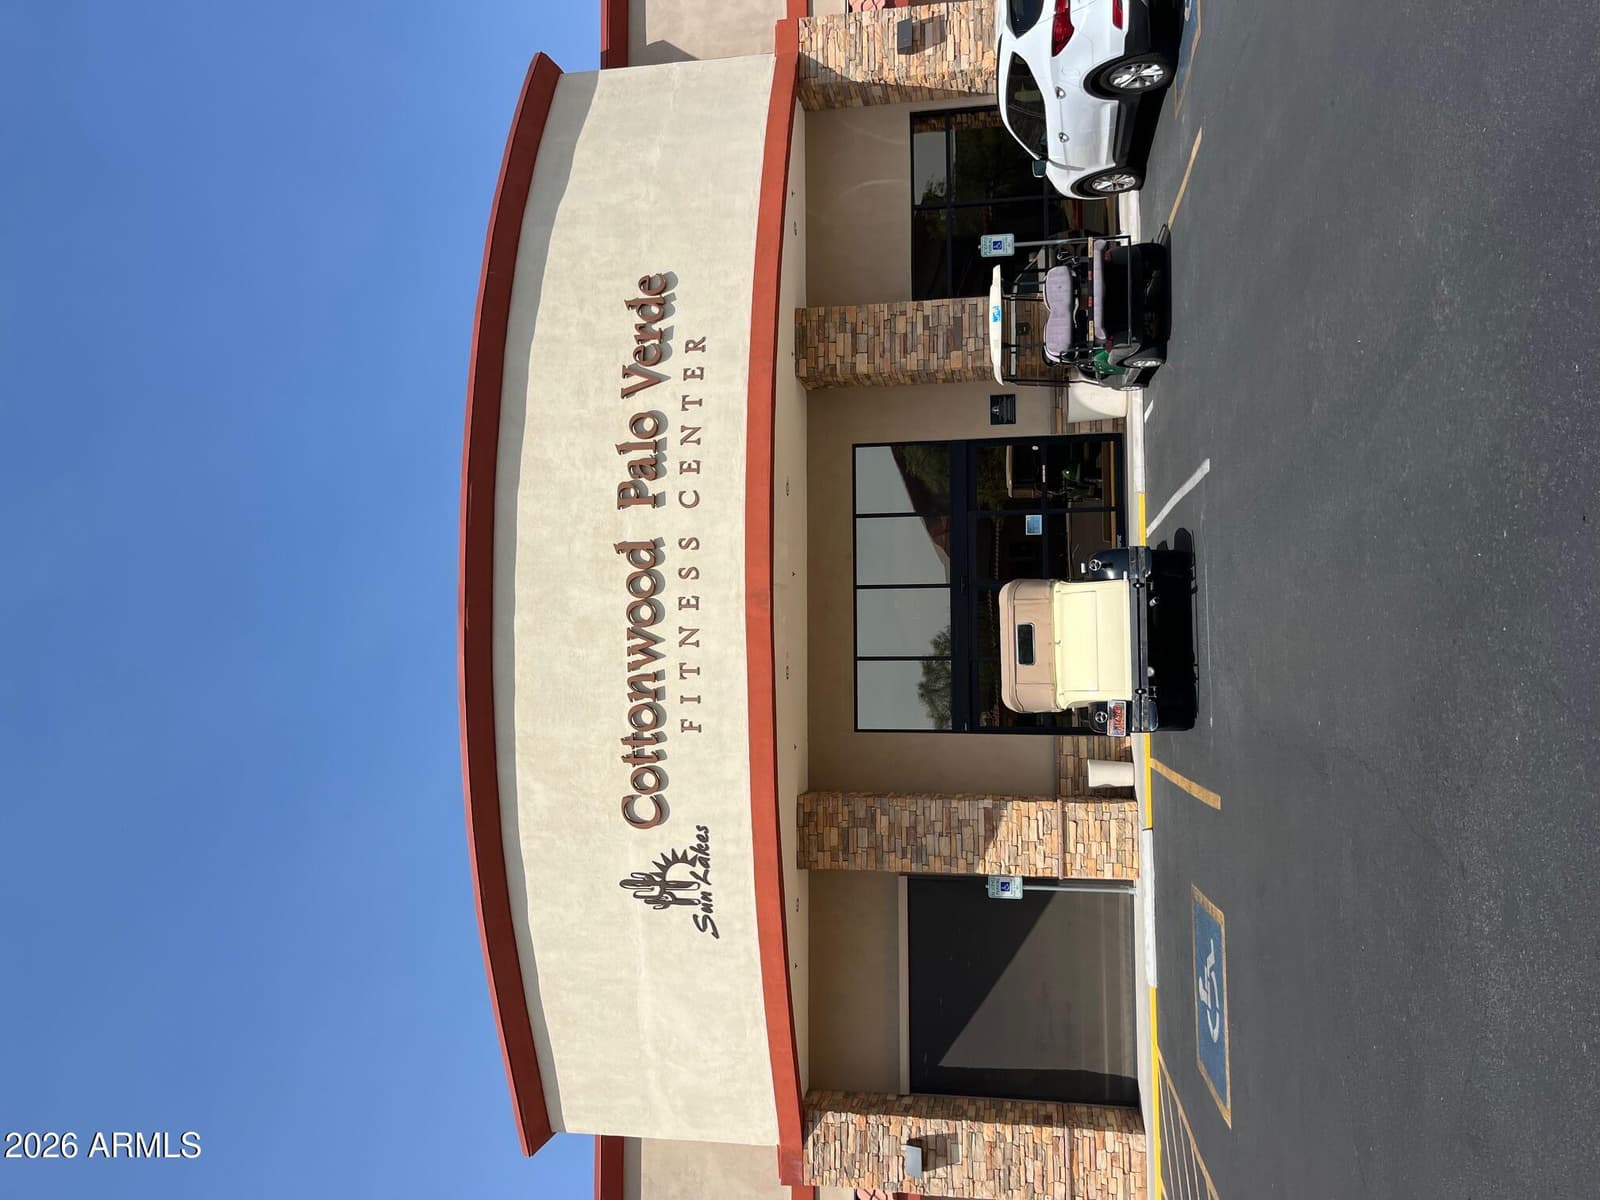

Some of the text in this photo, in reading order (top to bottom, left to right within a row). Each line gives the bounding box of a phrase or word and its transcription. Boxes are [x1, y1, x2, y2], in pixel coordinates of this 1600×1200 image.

[614, 273, 670, 829] Cottonwood Palo Verde
[678, 336, 706, 732] FITNESS CENTER
[689, 824, 719, 939] Sun Lakes
